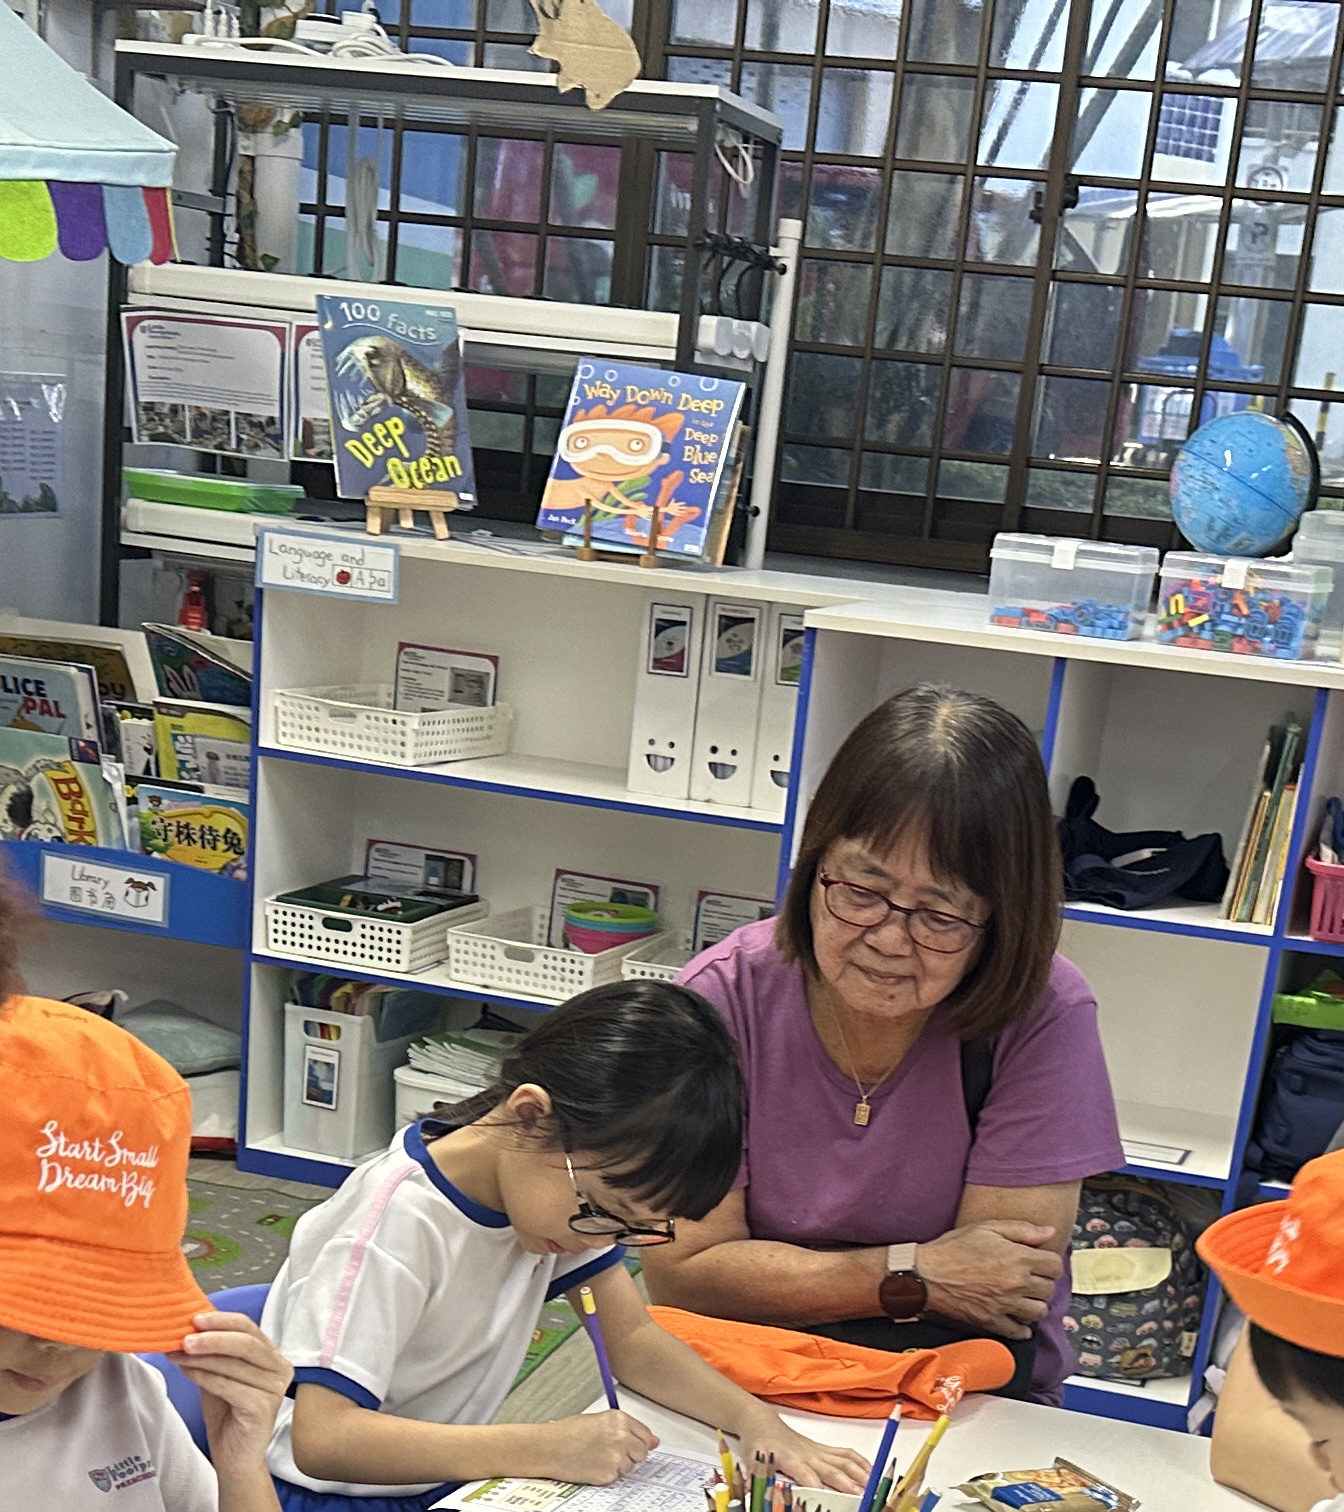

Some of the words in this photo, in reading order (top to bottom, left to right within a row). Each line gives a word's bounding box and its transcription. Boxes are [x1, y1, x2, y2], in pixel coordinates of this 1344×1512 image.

[339, 301, 381, 323] 100
[387, 313, 437, 341] facts
[583, 380, 621, 407] Way
[625, 385, 674, 406] Down
[677, 392, 725, 417] Deep
[344, 416, 410, 469] Deep
[684, 427, 720, 447] Deep
[386, 454, 463, 490] Ocean
[682, 445, 718, 466] Blue
[688, 468, 714, 485] Sea
[267, 538, 334, 568] Language
[341, 547, 365, 566] and
[22, 696, 67, 719] PAL
[151, 816, 245, 856] 守株待兔
[36, 1119, 107, 1162] Start
[103, 1130, 160, 1168] Small
[37, 1157, 121, 1193] Dream
[118, 1170, 157, 1209] Big
